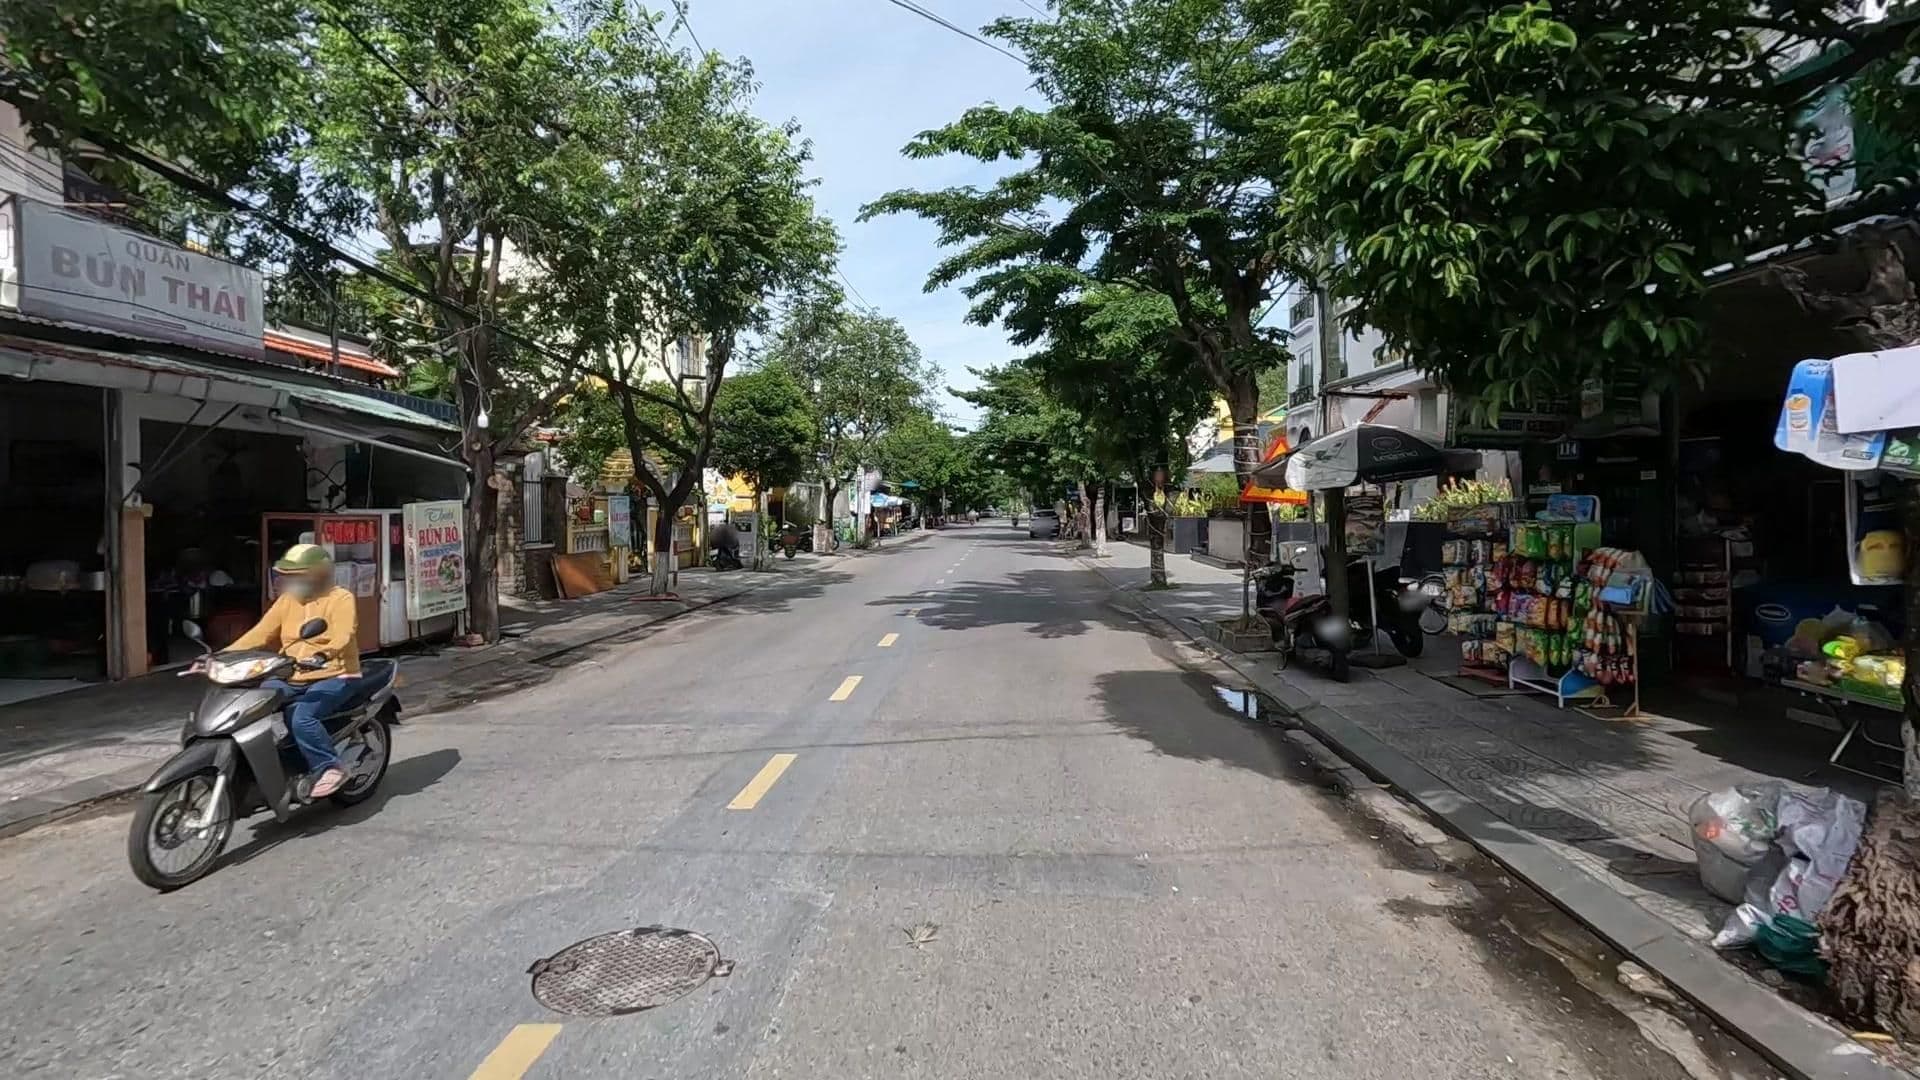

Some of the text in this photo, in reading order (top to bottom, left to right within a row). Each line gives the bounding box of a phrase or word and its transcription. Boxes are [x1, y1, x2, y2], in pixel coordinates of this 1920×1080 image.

[51, 245, 247, 322] BÚN THÁI
[418, 523, 442, 546] BÚN
[444, 521, 459, 543] BÒ
